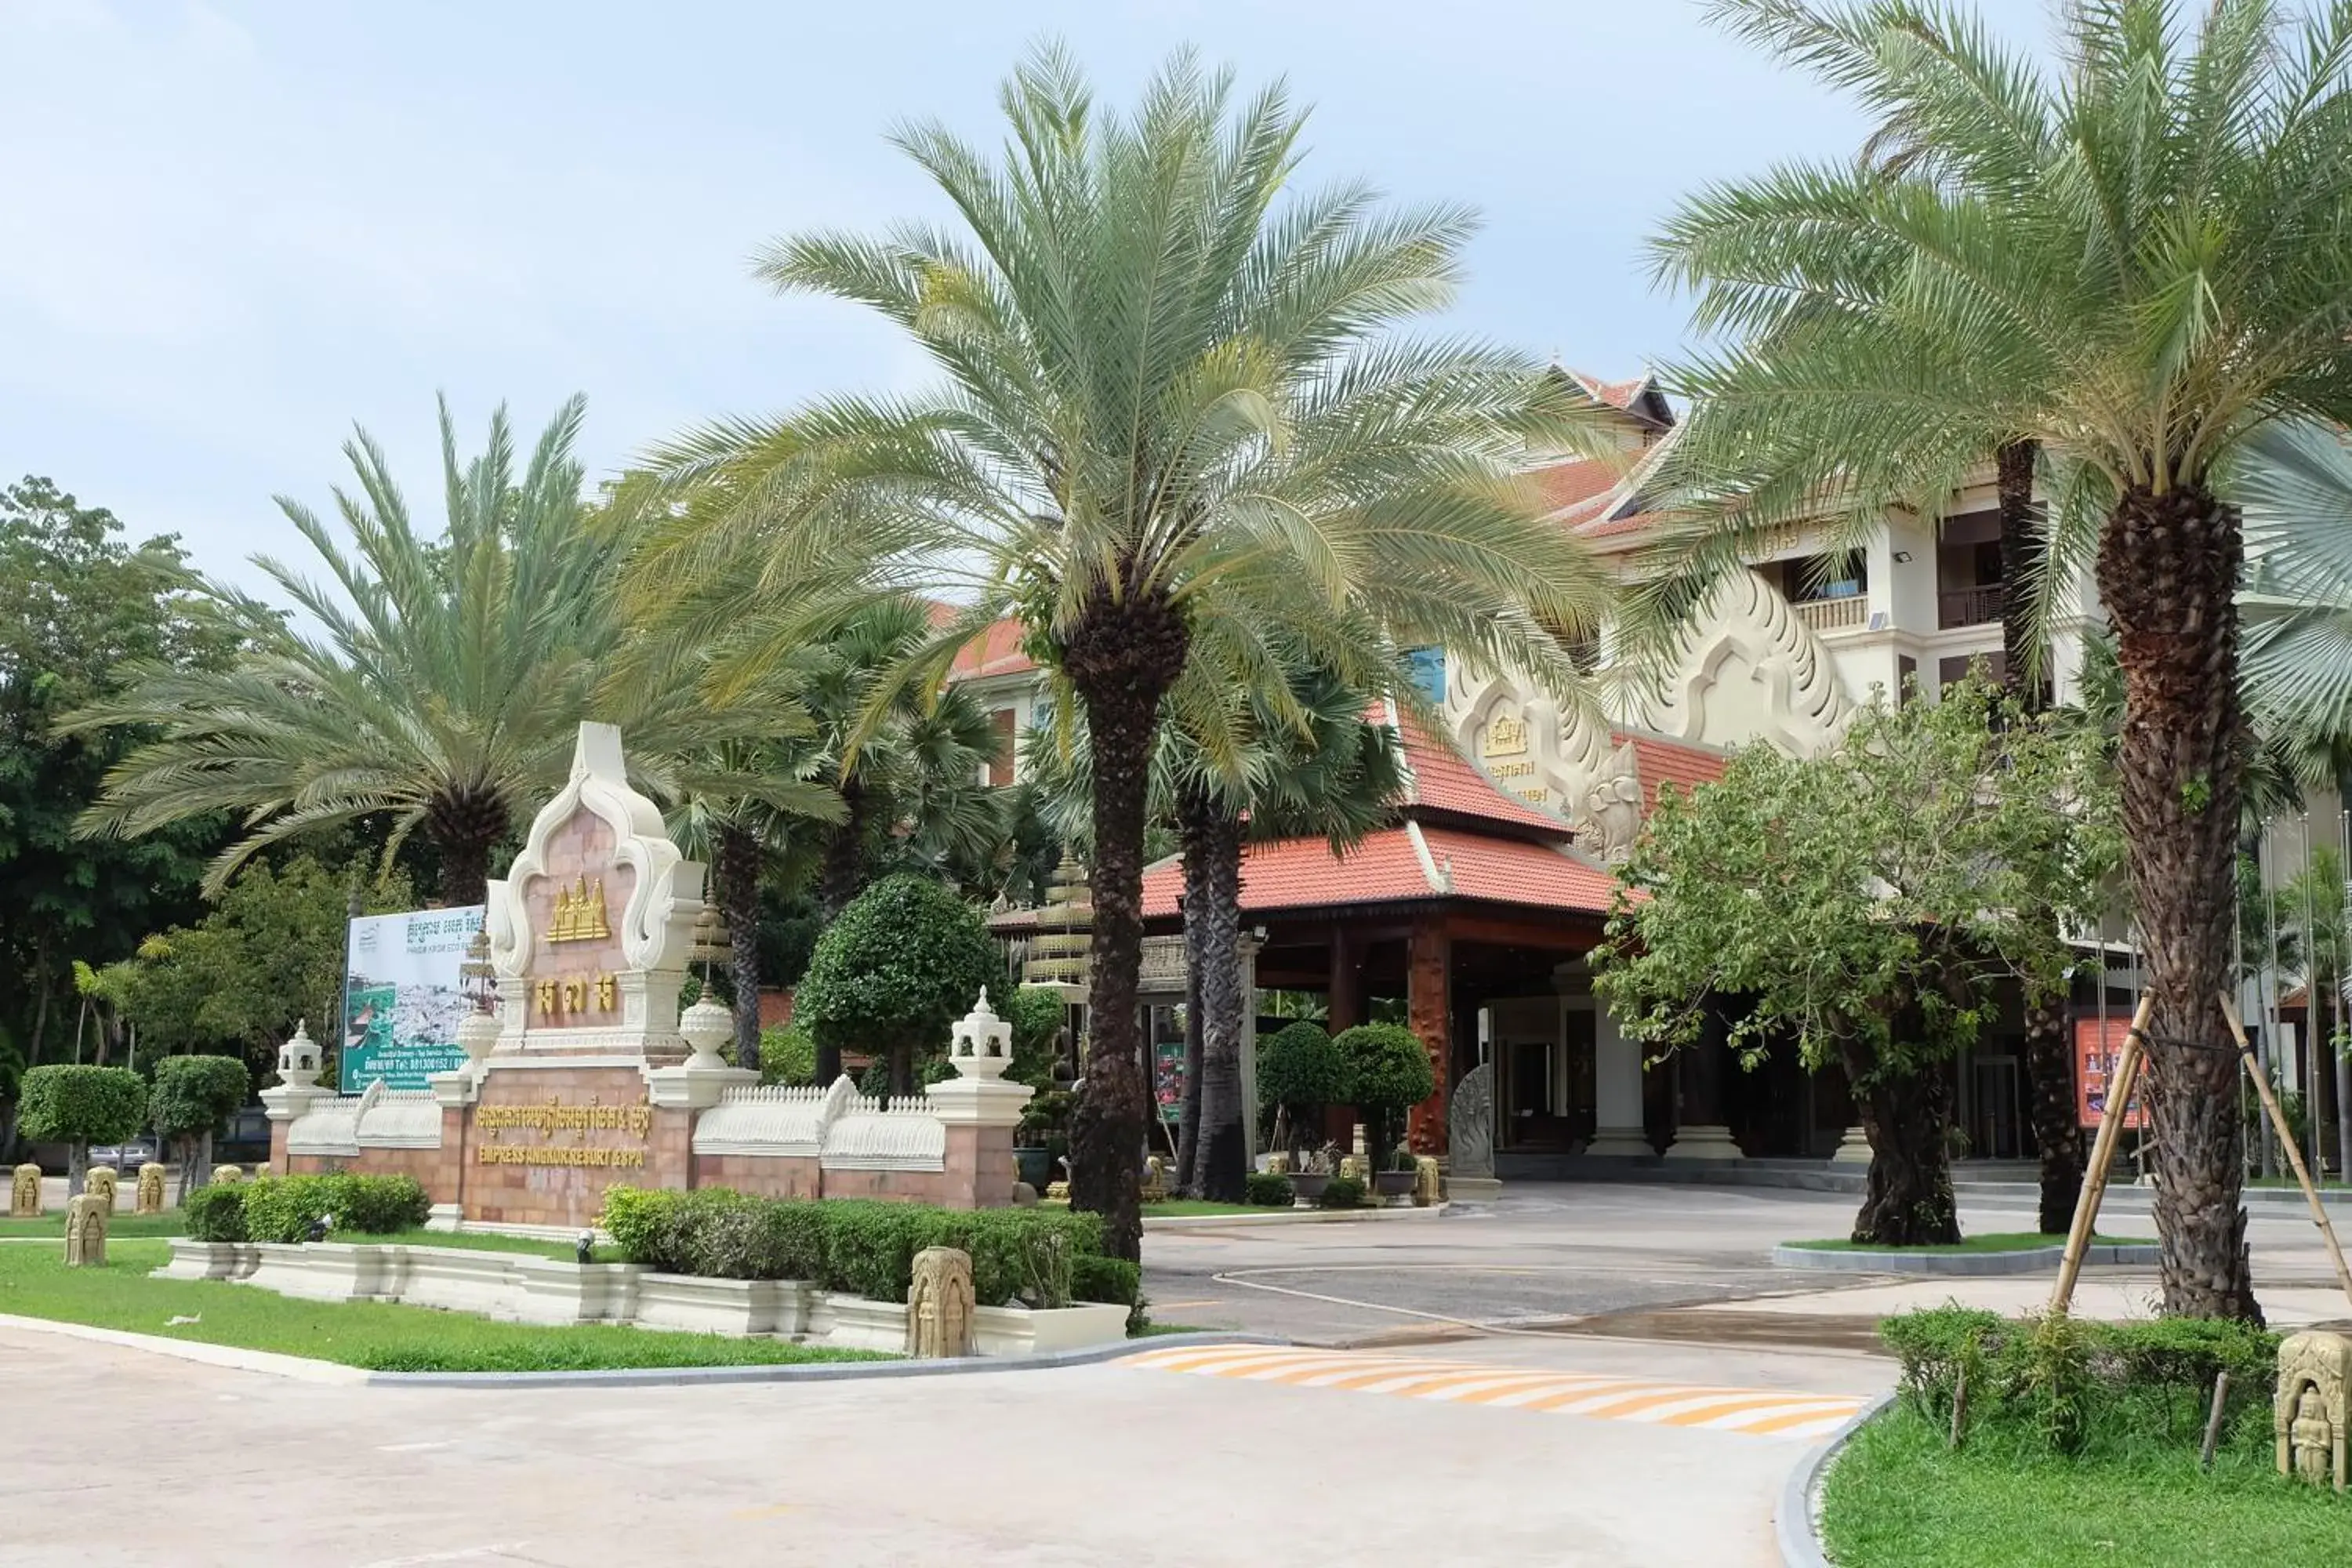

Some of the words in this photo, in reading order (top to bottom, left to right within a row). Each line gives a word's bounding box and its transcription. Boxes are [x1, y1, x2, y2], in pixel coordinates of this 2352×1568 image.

[479, 1145, 526, 1163] EMPRESS
[526, 1145, 568, 1165] ANGKOR
[569, 1147, 609, 1166] RESORT
[621, 1148, 644, 1167] SPA
